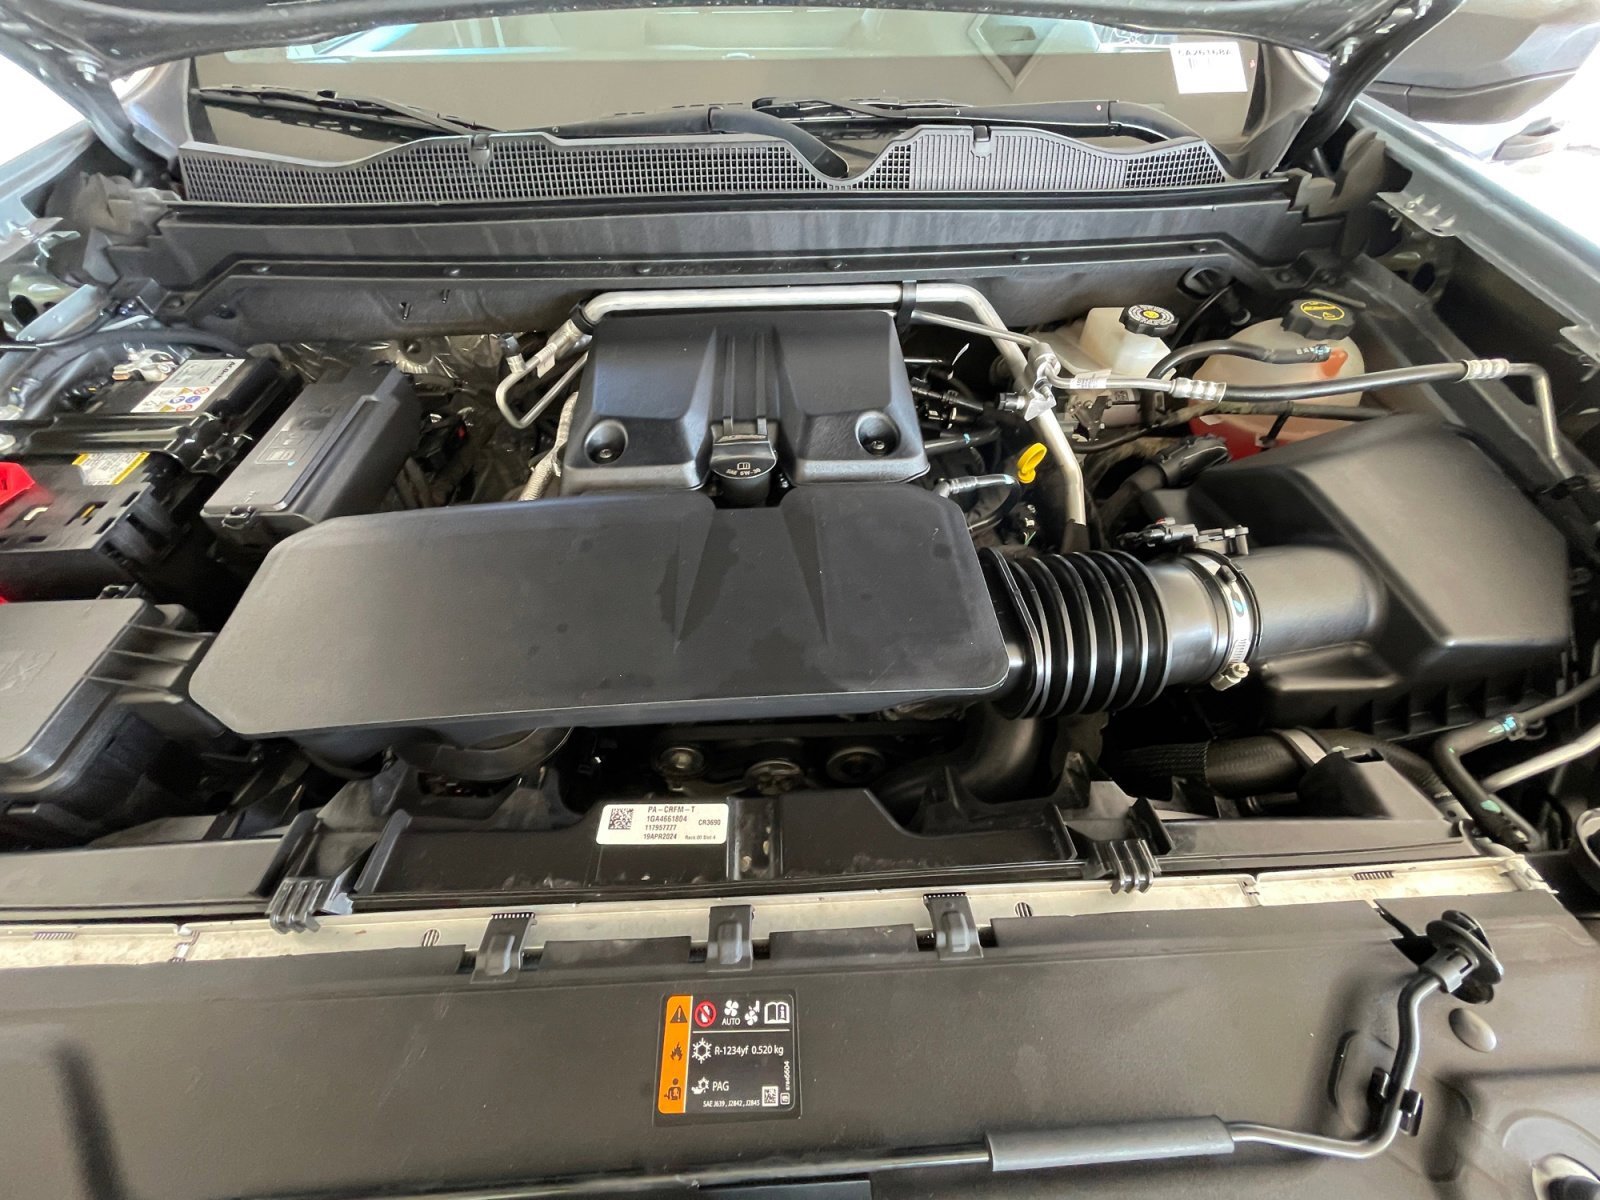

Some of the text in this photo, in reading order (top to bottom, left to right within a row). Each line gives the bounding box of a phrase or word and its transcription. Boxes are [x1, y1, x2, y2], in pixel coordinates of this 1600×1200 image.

[646, 815, 688, 823] 1GA4661804
[722, 1017, 741, 1025] AUTO
[714, 1045, 784, 1057] R-1234yf 0.520 kg
[712, 1081, 730, 1092] PAG
[703, 1100, 713, 1108] SAE
